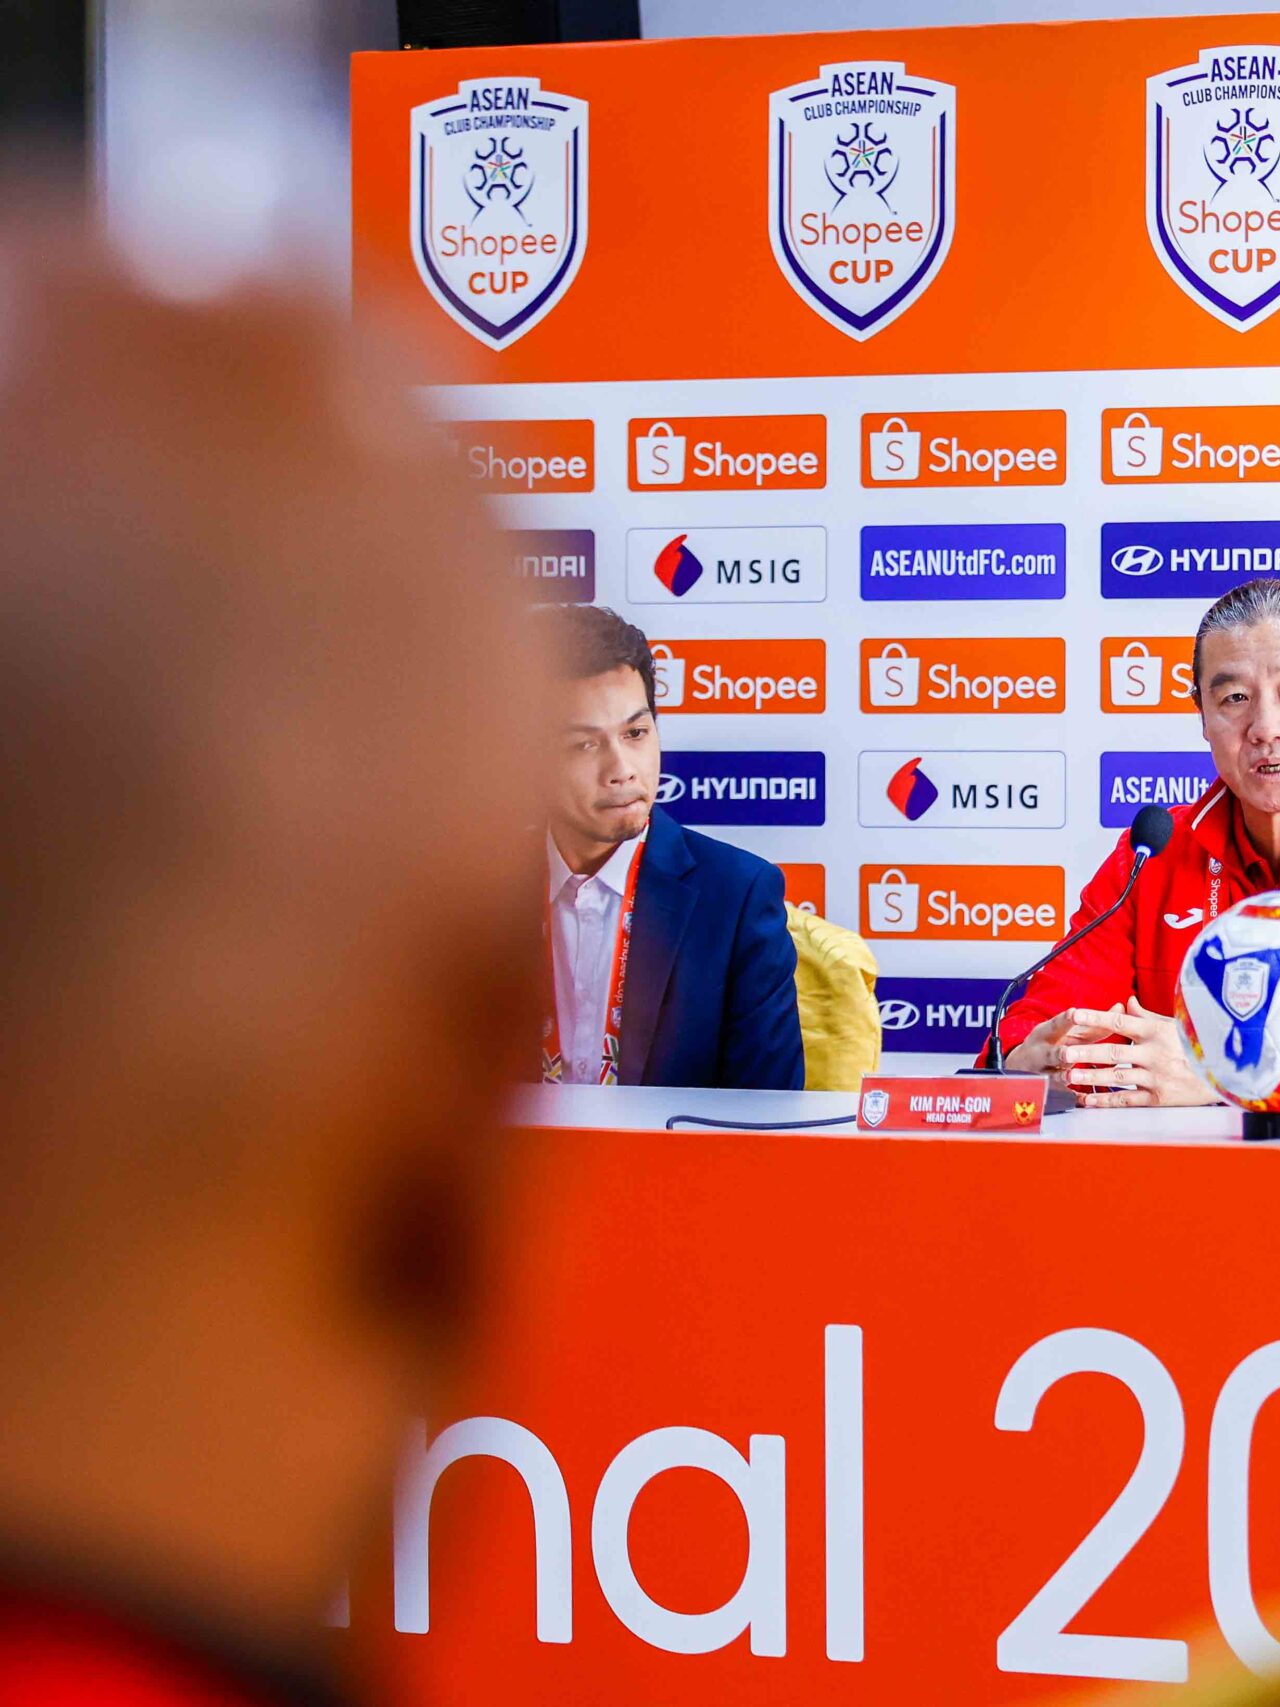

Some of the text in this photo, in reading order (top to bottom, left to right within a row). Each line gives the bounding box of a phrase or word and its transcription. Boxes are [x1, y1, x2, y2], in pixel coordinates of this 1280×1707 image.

[1211, 56, 1276, 83] ASEAN
[831, 72, 894, 97] ASEAN
[470, 88, 529, 112] ASEAN
[1182, 89, 1212, 106] CLUB
[804, 100, 921, 121] CLUB CHAMPIONSHIP
[444, 115, 556, 135] CLUB CHAMPIONSHIP
[440, 225, 557, 264] Shopee
[800, 213, 923, 257] Shopee
[829, 260, 893, 284] CUP
[1208, 248, 1276, 273] CUP
[468, 271, 528, 295] CUP
[468, 446, 587, 489] Shopee
[693, 442, 818, 485] Shopee
[928, 438, 1057, 482] Shopee
[716, 559, 801, 584] MSIG
[870, 549, 1056, 577] ASEANUtdFC.com
[692, 665, 818, 709] Shopee
[927, 665, 1057, 709] Shopee
[691, 777, 816, 800] HYUNDAI
[952, 784, 1039, 809] MSIG
[1207, 878, 1221, 918] Shopee
[927, 890, 1055, 936] Shopee
[910, 1096, 991, 1113] KIM PAN-GON
[926, 1113, 972, 1124] HEAD COACH
[394, 1323, 864, 1662] nal
